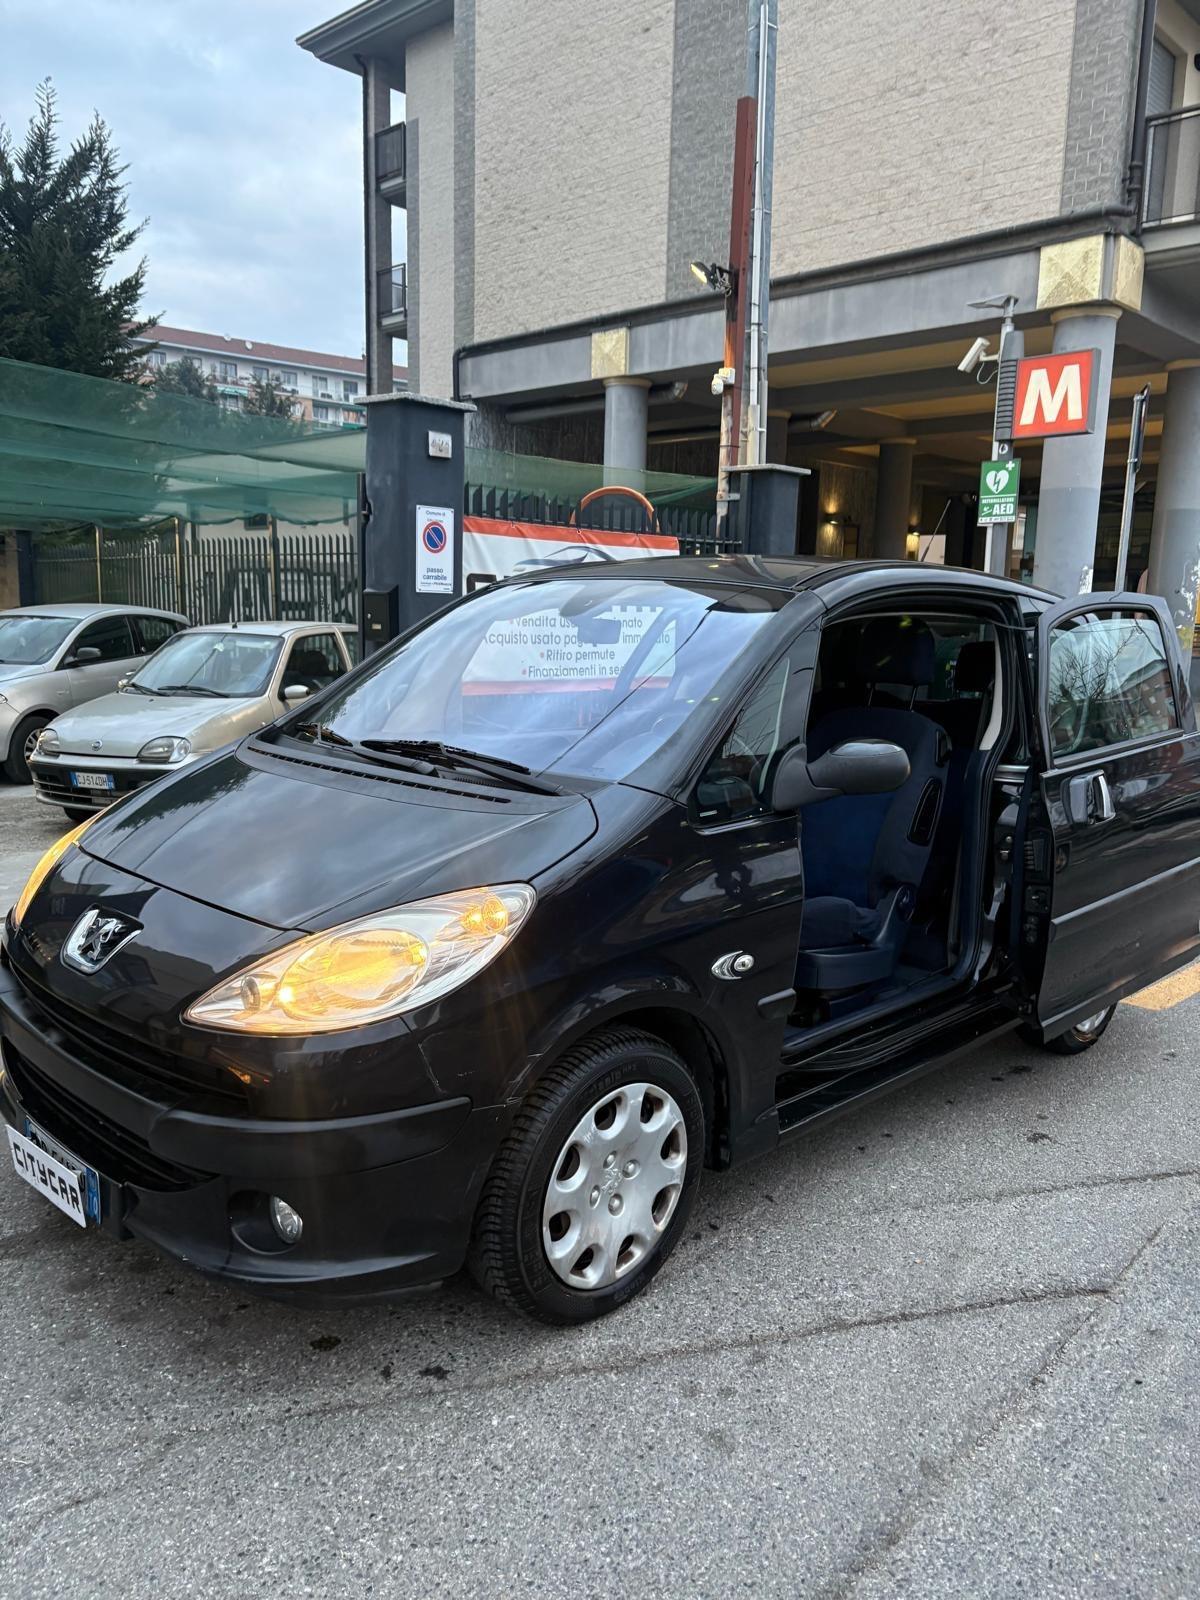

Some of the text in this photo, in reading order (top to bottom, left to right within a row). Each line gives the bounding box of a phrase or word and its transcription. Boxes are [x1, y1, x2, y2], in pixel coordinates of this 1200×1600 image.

[1019, 363, 1083, 426] M
[992, 503, 1014, 515] AED
[530, 631, 562, 645] usato
[546, 649, 615, 662] Ritiro permute
[528, 665, 596, 678] Finanziamenti
[599, 665, 607, 676] in
[13, 1142, 81, 1214] CITYCAR
